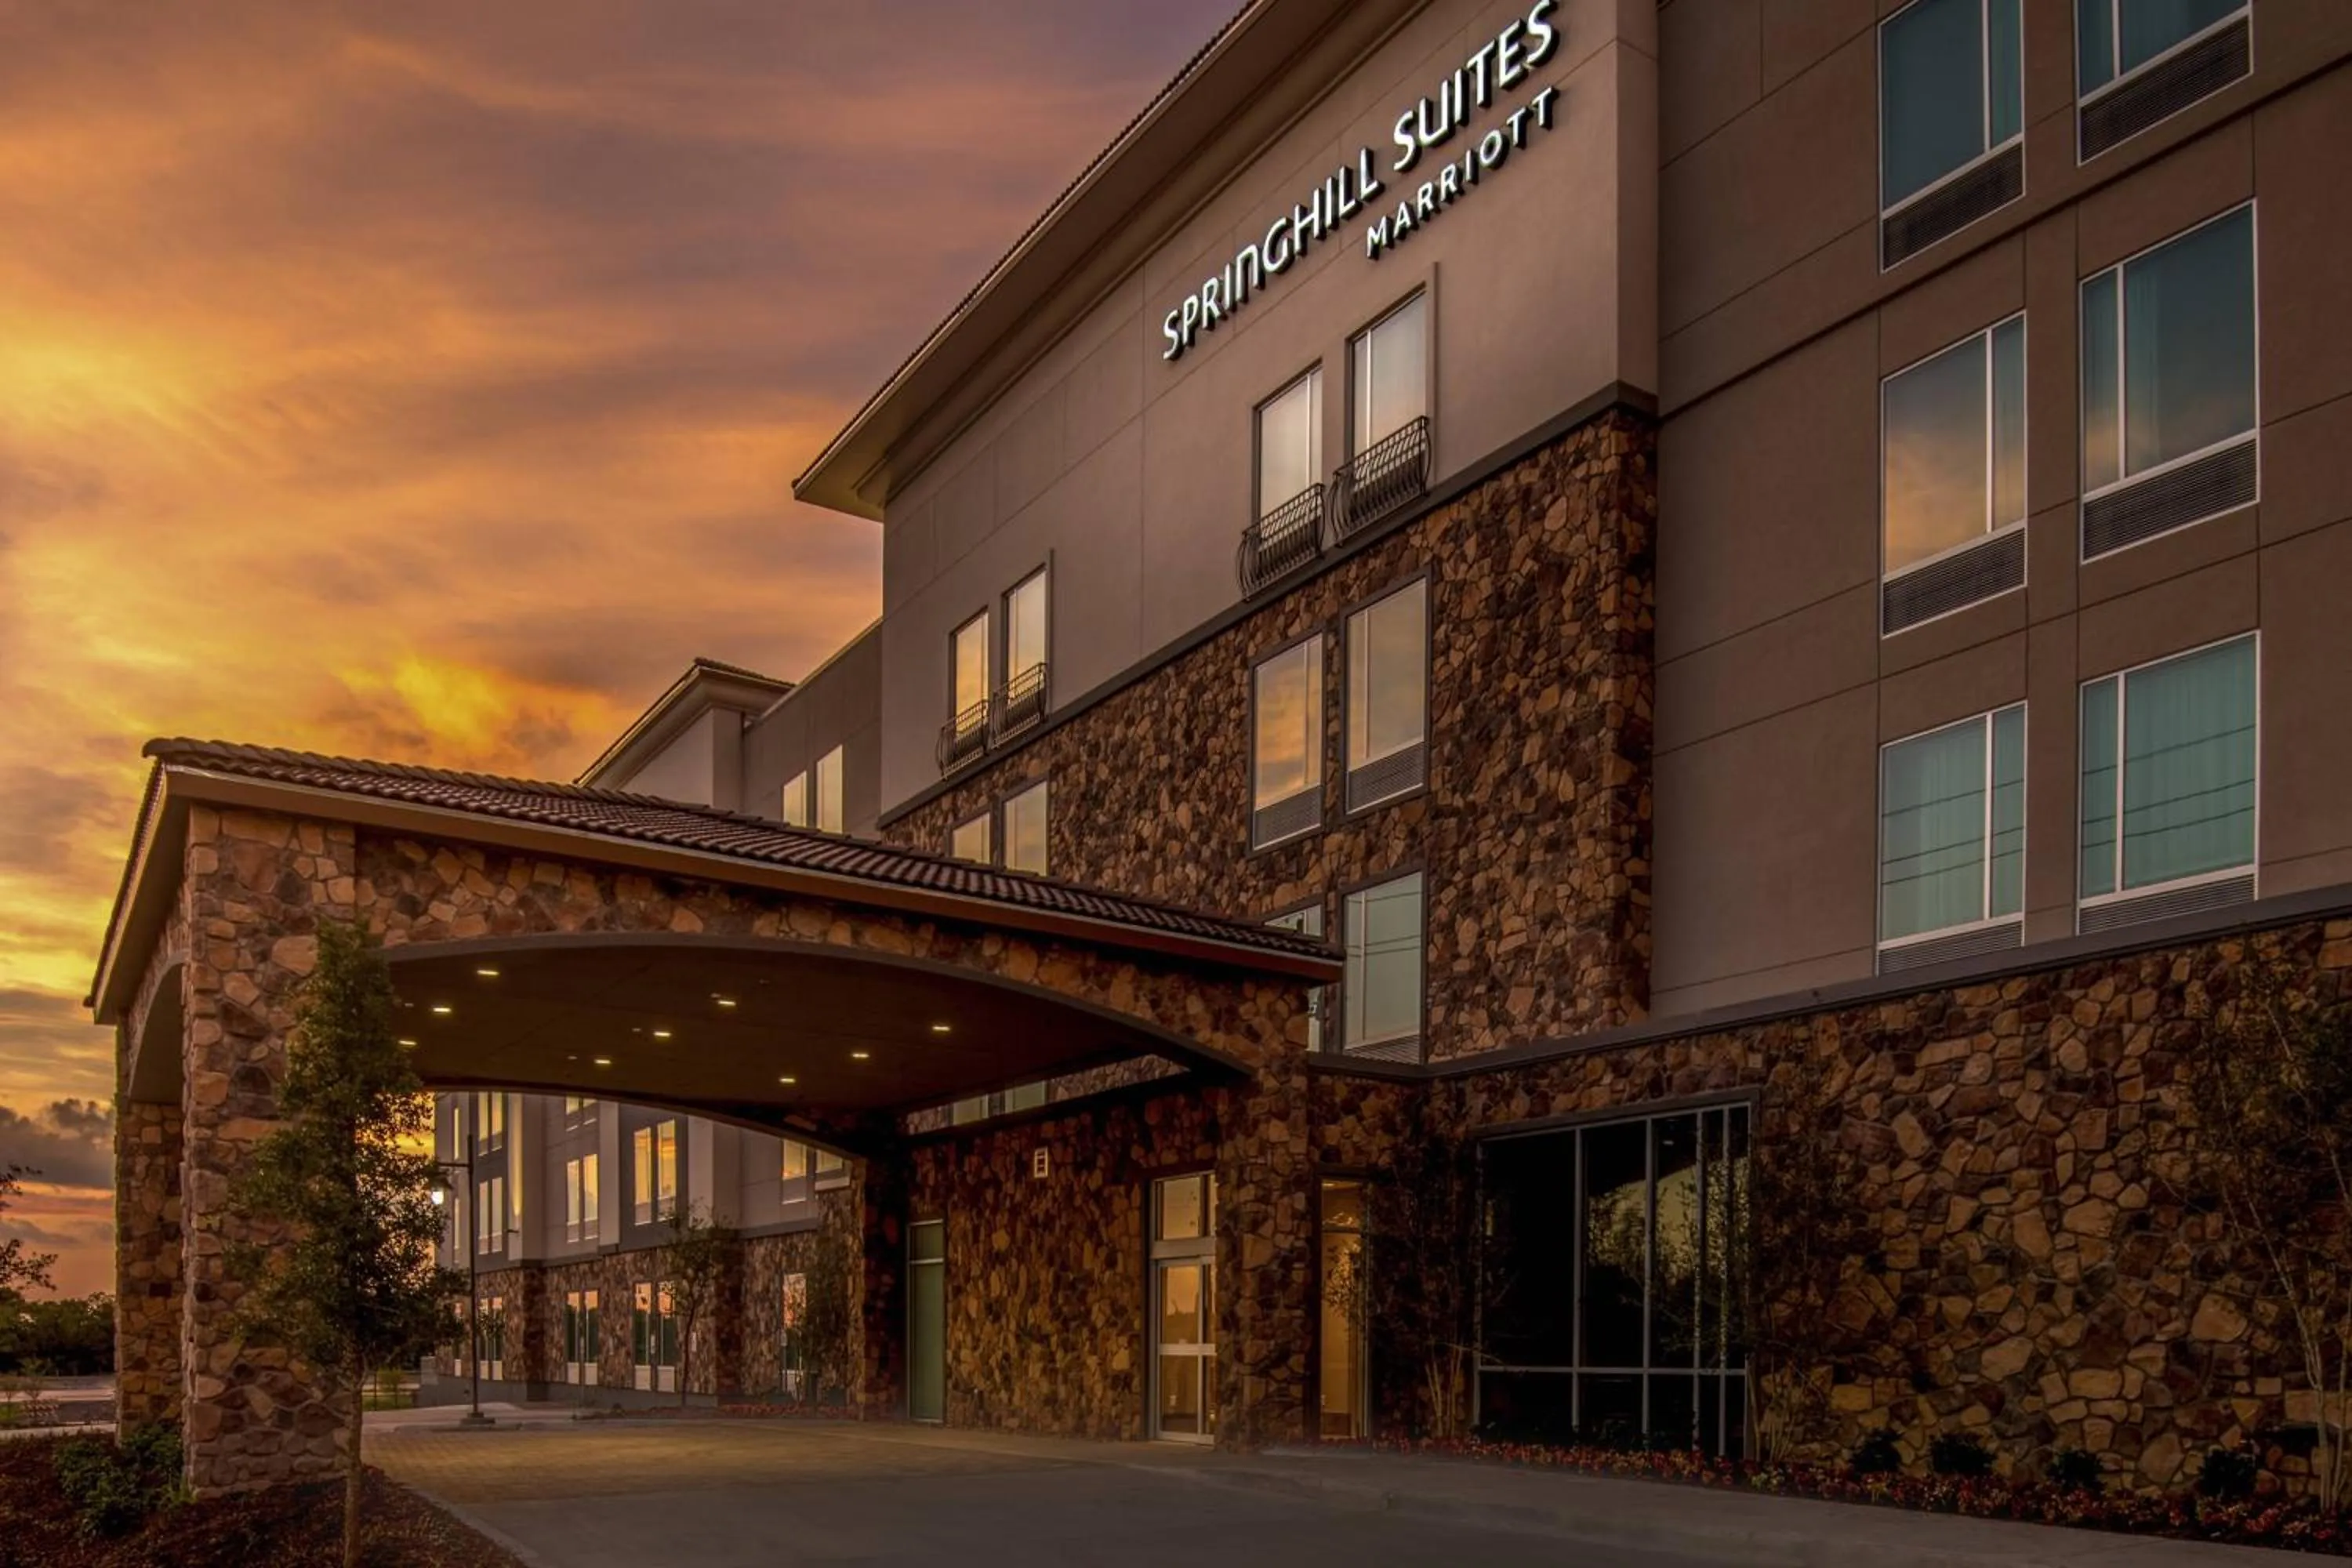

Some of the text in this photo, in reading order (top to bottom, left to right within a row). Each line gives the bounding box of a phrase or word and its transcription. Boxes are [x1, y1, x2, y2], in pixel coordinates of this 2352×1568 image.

[1163, 0, 1556, 361] SPRINGHILL SUITES
[1367, 86, 1556, 259] MARRIOTT
